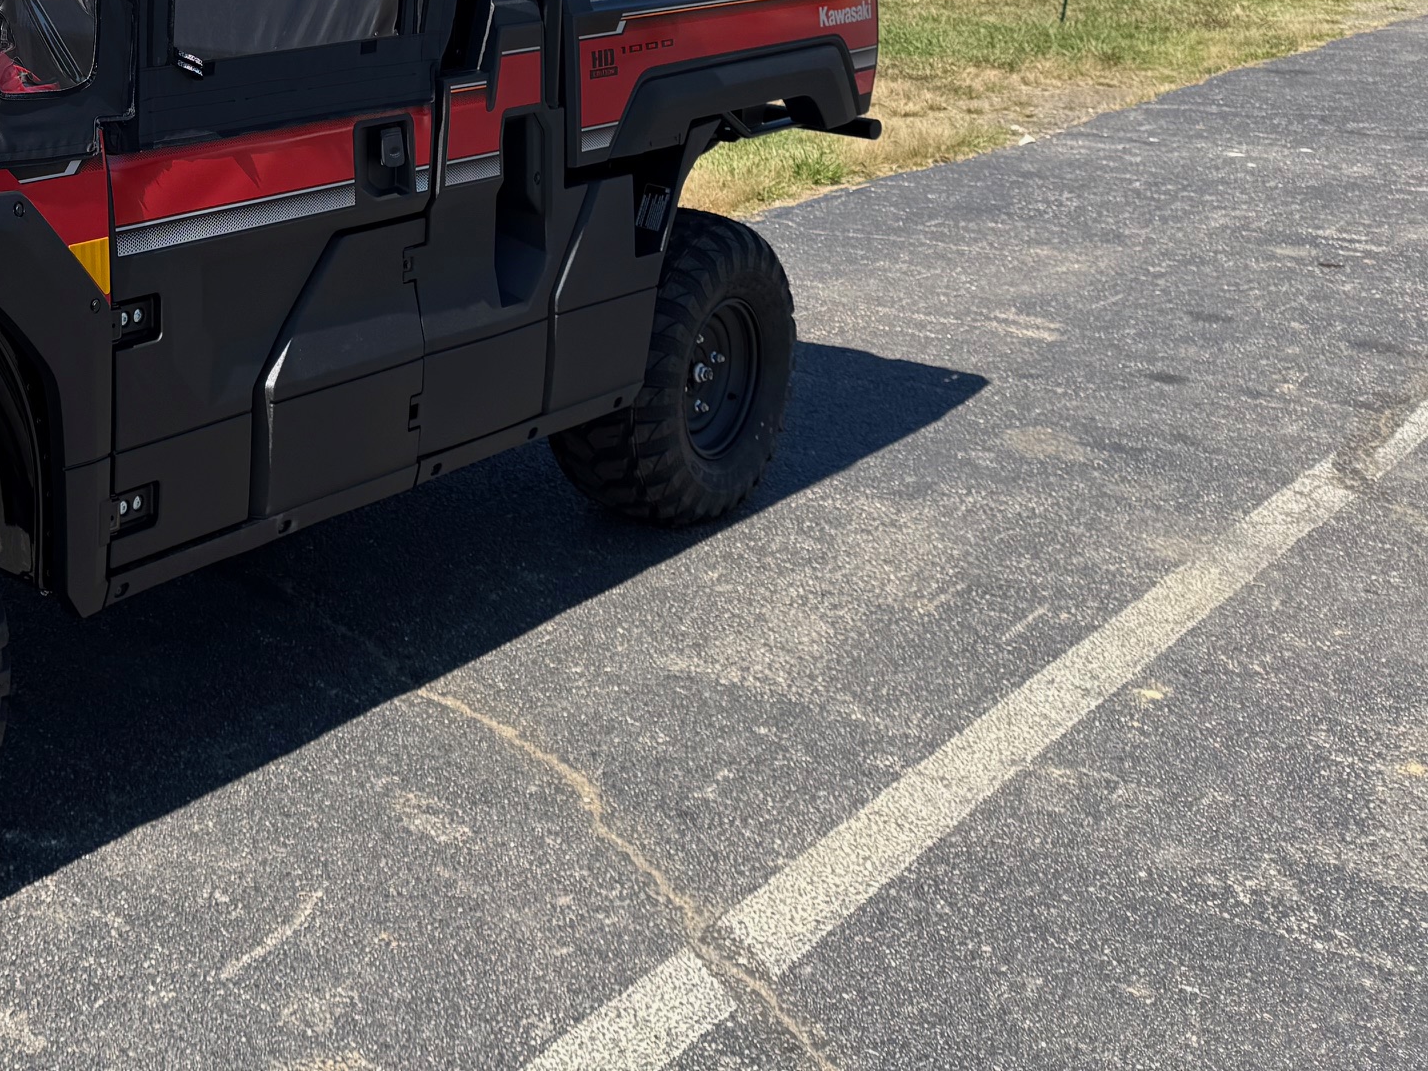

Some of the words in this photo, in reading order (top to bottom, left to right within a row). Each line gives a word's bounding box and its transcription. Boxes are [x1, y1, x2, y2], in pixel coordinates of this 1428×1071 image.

[818, 0, 872, 27] Kawasaki
[591, 48, 615, 68] HD
[621, 39, 674, 55] 1000
